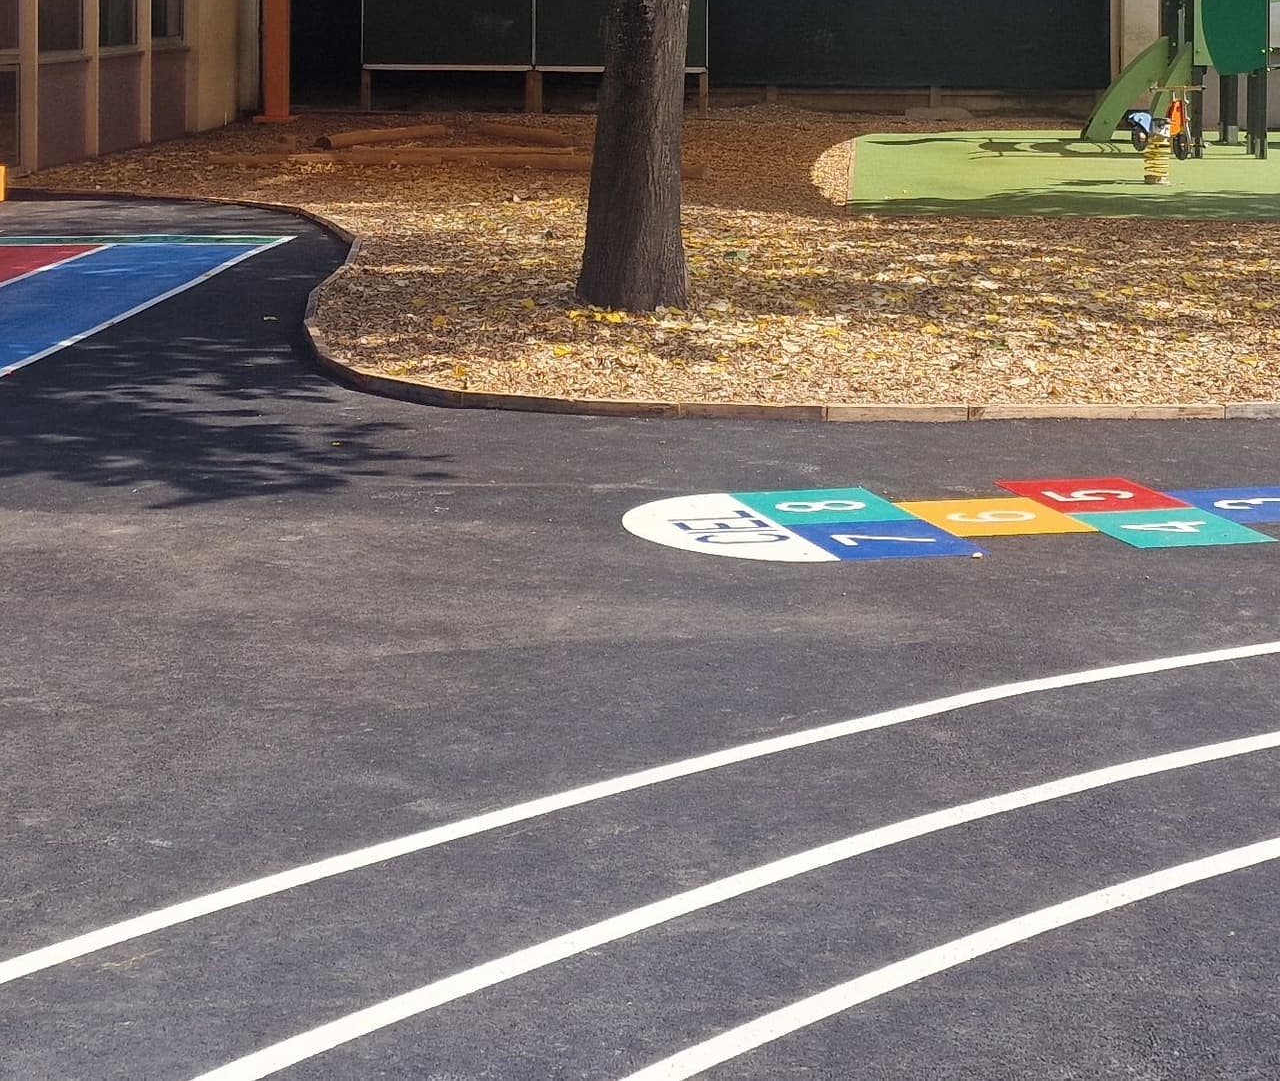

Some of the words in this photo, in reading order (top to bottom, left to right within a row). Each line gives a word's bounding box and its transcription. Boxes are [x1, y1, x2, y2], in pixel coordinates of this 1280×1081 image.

[1041, 489, 1135, 502] 5
[775, 500, 867, 513] 8
[667, 510, 791, 544] CIEL
[1120, 520, 1207, 533] 4
[830, 534, 937, 547] 7
